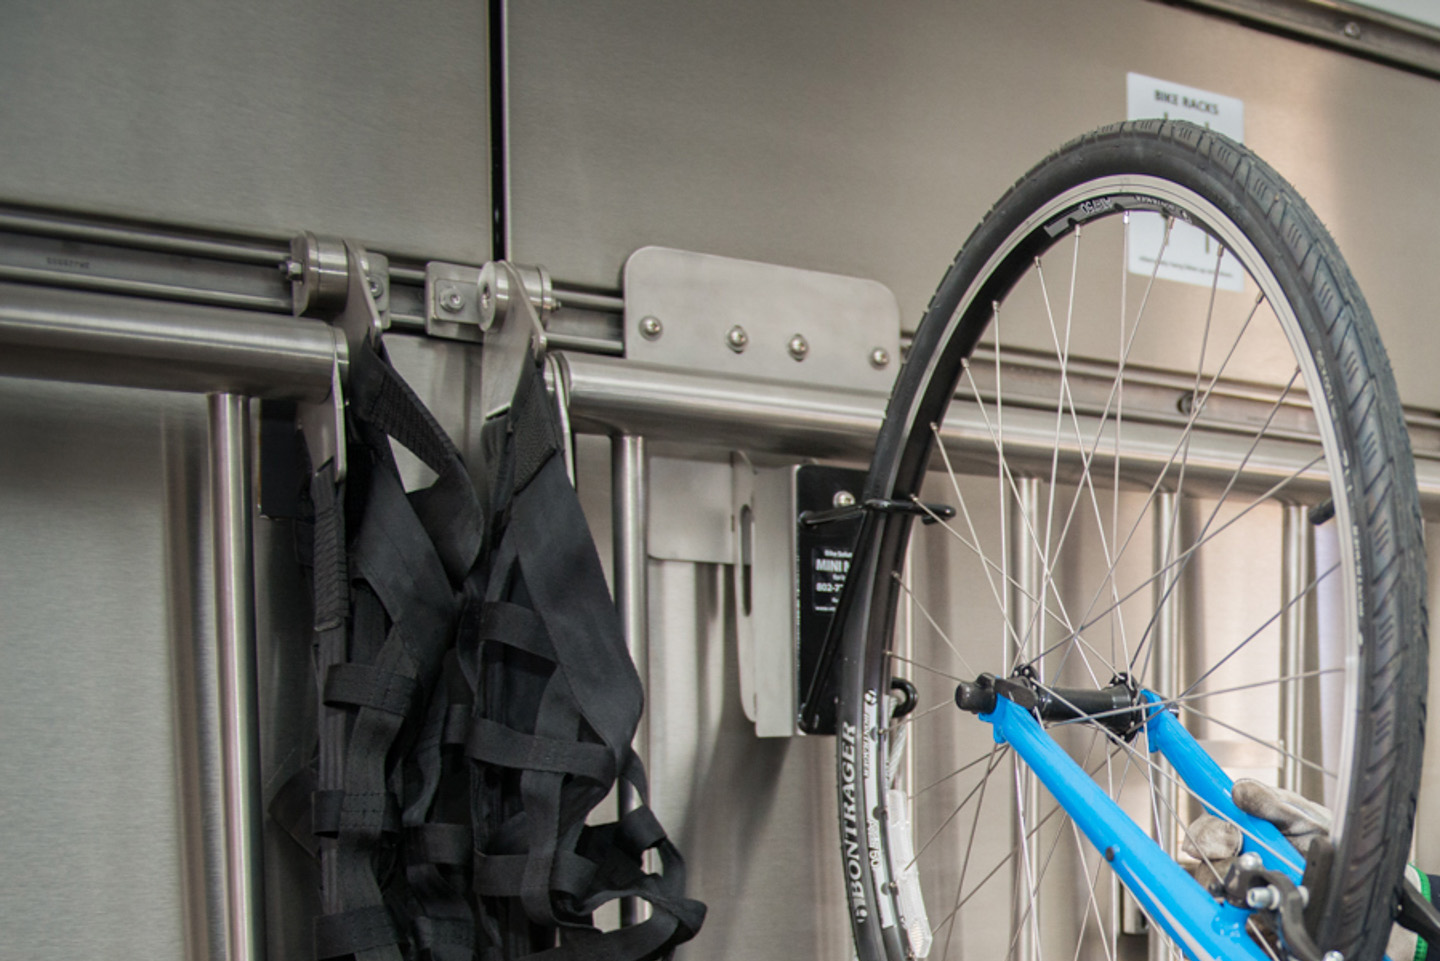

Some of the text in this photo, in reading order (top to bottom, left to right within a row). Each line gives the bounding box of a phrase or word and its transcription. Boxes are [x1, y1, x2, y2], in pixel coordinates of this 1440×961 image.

[1154, 90, 1219, 115] BIKE RACKS
[815, 558, 842, 572] MINI
[842, 721, 867, 906] BONTRAGER
